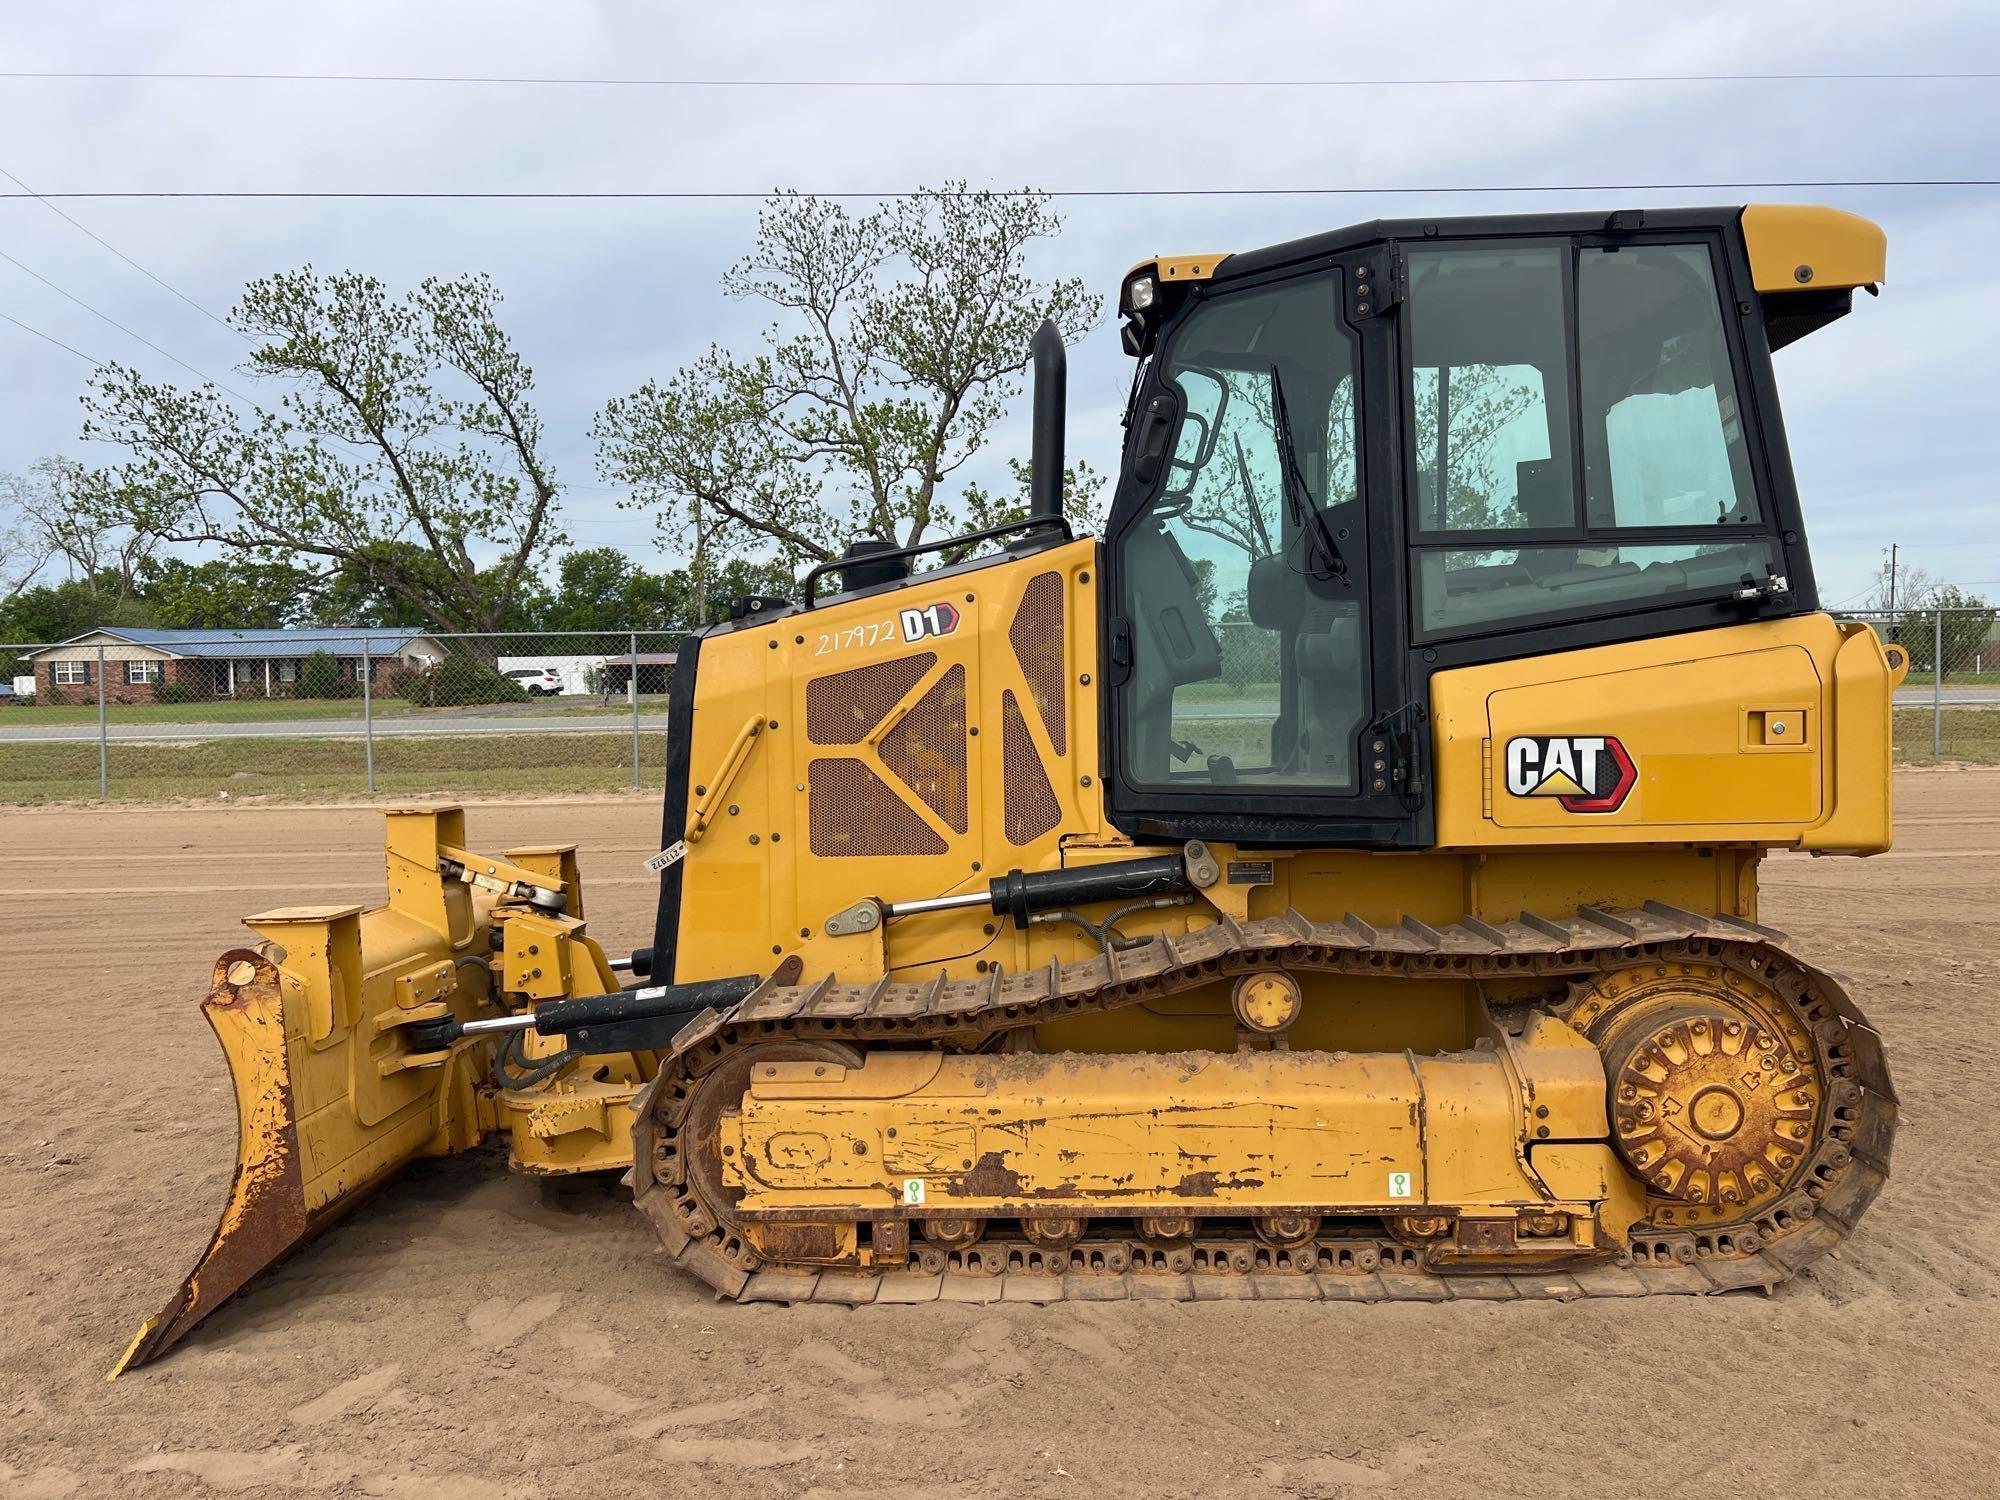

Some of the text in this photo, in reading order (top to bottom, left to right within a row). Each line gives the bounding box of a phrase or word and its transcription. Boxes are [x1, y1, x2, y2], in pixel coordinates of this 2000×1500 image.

[815, 620, 896, 656] 217972
[900, 605, 941, 642] D1
[1507, 738, 1605, 795] CAT
[651, 849, 680, 870] 217972
